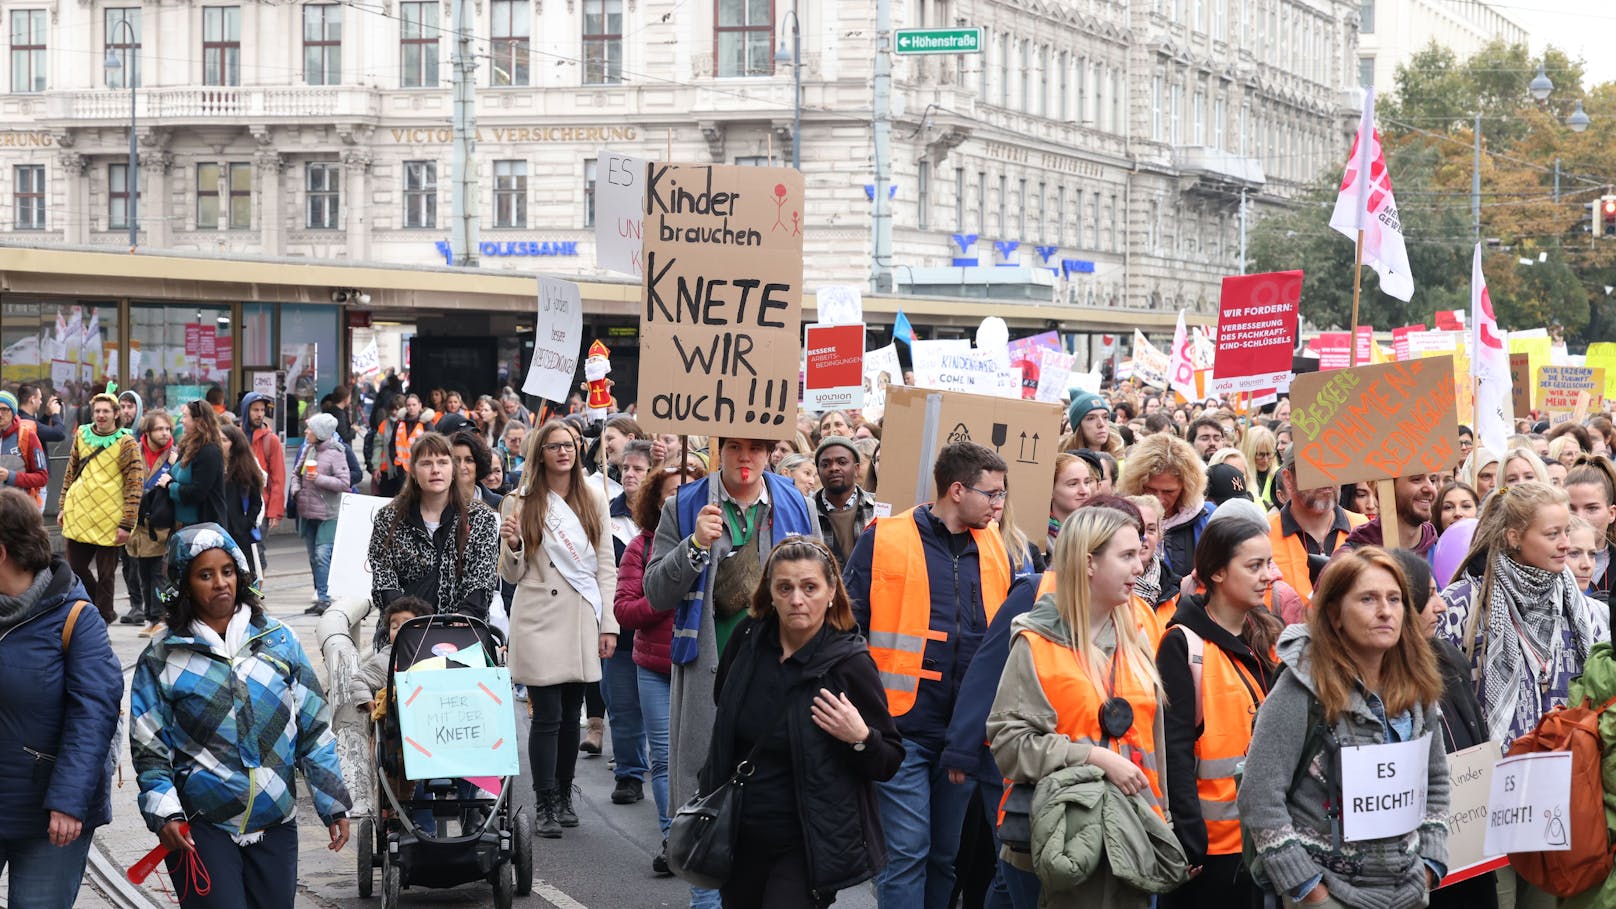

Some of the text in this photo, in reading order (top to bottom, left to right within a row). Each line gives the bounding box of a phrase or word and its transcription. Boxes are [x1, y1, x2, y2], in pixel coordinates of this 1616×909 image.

[912, 34, 977, 48] Höhenstraße
[492, 126, 637, 143] VERSICHERUNG
[608, 157, 634, 187] ES
[647, 161, 740, 217] Kinder
[618, 218, 644, 240] UN
[659, 213, 762, 246] brauchen
[647, 251, 791, 329] KNETE
[1223, 303, 1293, 318] WIR FORDERN:
[1221, 319, 1283, 332] VERBESSERUNG
[1219, 336, 1292, 351] KIND-SCHLÜSSELS
[1220, 328, 1287, 342] DES FACHKRAFT-
[672, 332, 757, 377] WIR
[807, 346, 837, 356] BESSERE
[811, 353, 840, 362] ARBEITS-
[815, 357, 862, 369] BEDINGUNGEN
[1560, 367, 1593, 375] ERZIEHEN
[1215, 381, 1233, 390] vida
[815, 393, 852, 404] younion
[1290, 368, 1361, 441] BESSERE
[440, 696, 469, 709] HER
[427, 709, 485, 726] MIT DER
[1376, 761, 1396, 779] ES
[1504, 774, 1516, 793] ES
[1353, 788, 1415, 814] REICHT!
[1491, 805, 1533, 829] REICHT!
